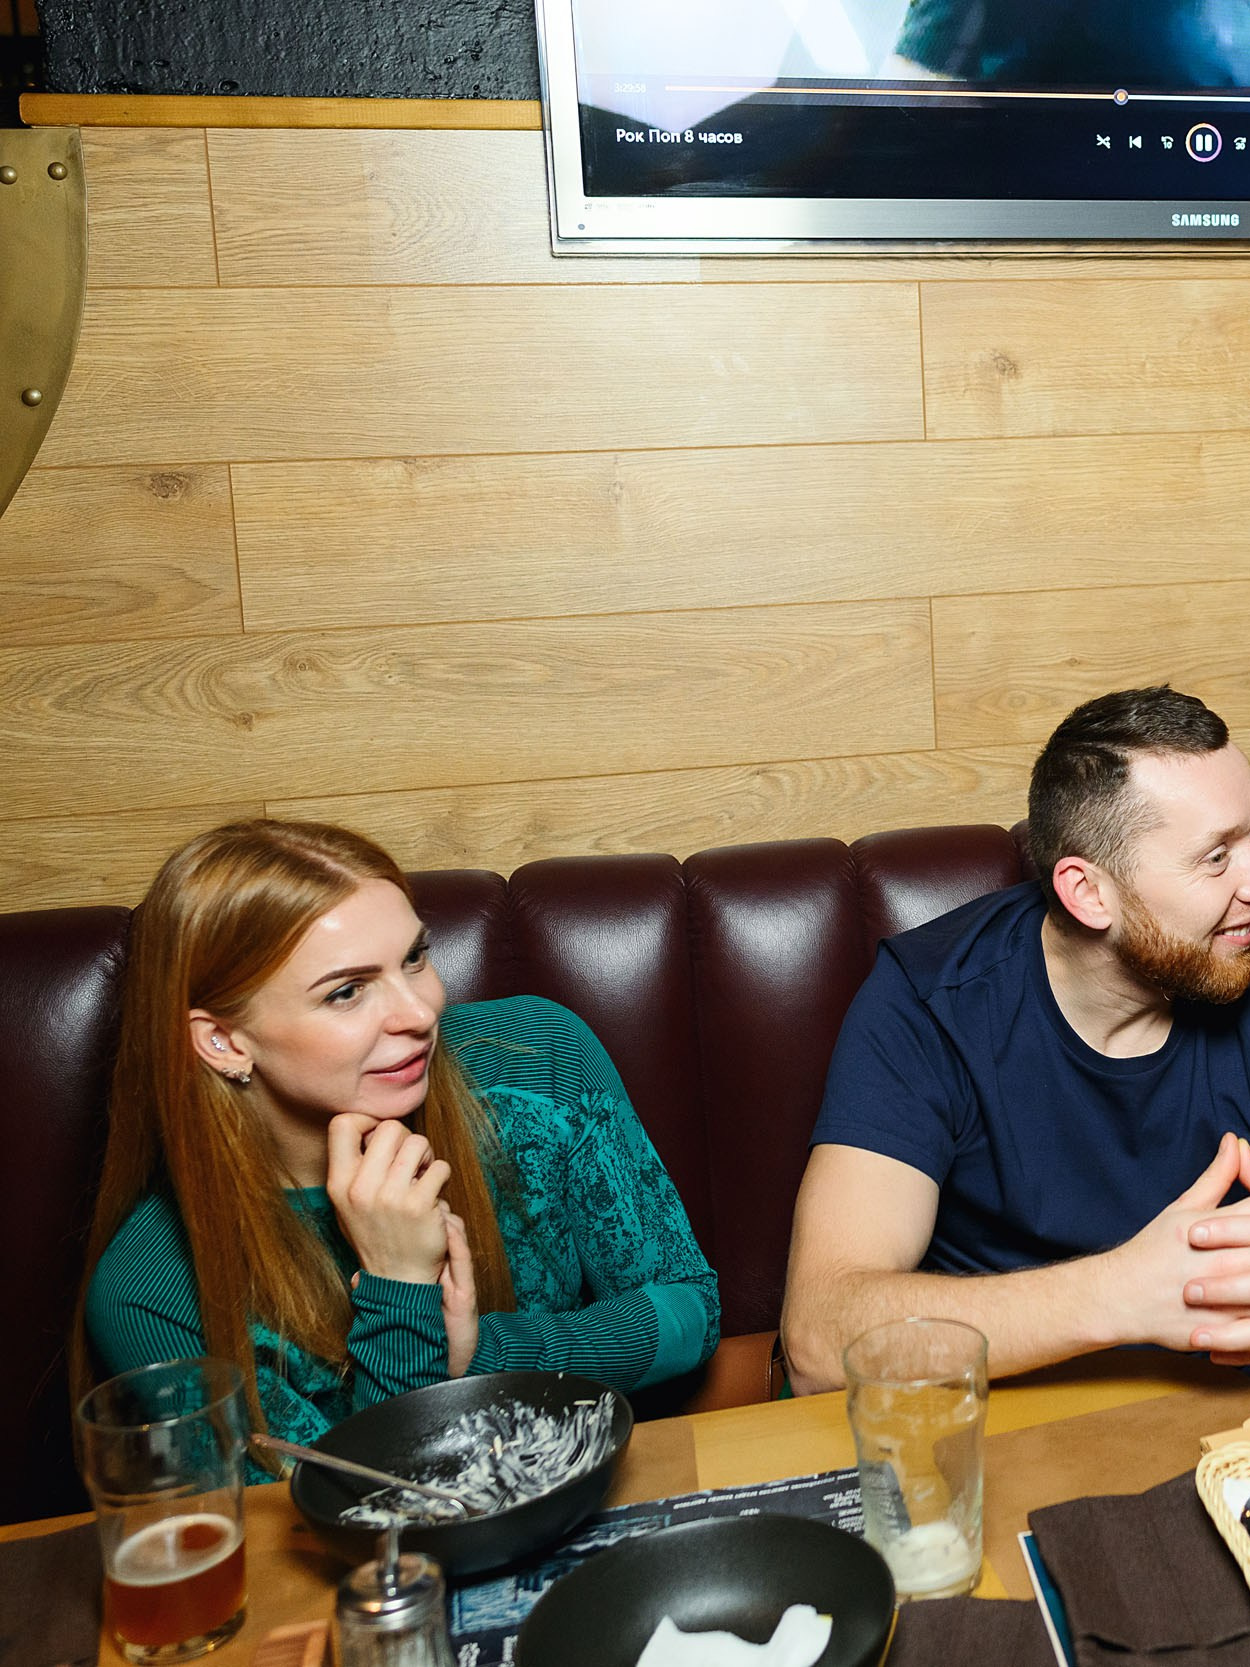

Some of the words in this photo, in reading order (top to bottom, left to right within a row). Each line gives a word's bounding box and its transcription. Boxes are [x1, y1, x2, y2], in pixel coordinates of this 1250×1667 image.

[616, 128, 645, 143] Рок
[649, 129, 681, 143] Поп
[684, 129, 694, 144] 8
[698, 132, 743, 144] часов
[1172, 214, 1240, 227] SAMSUNG
